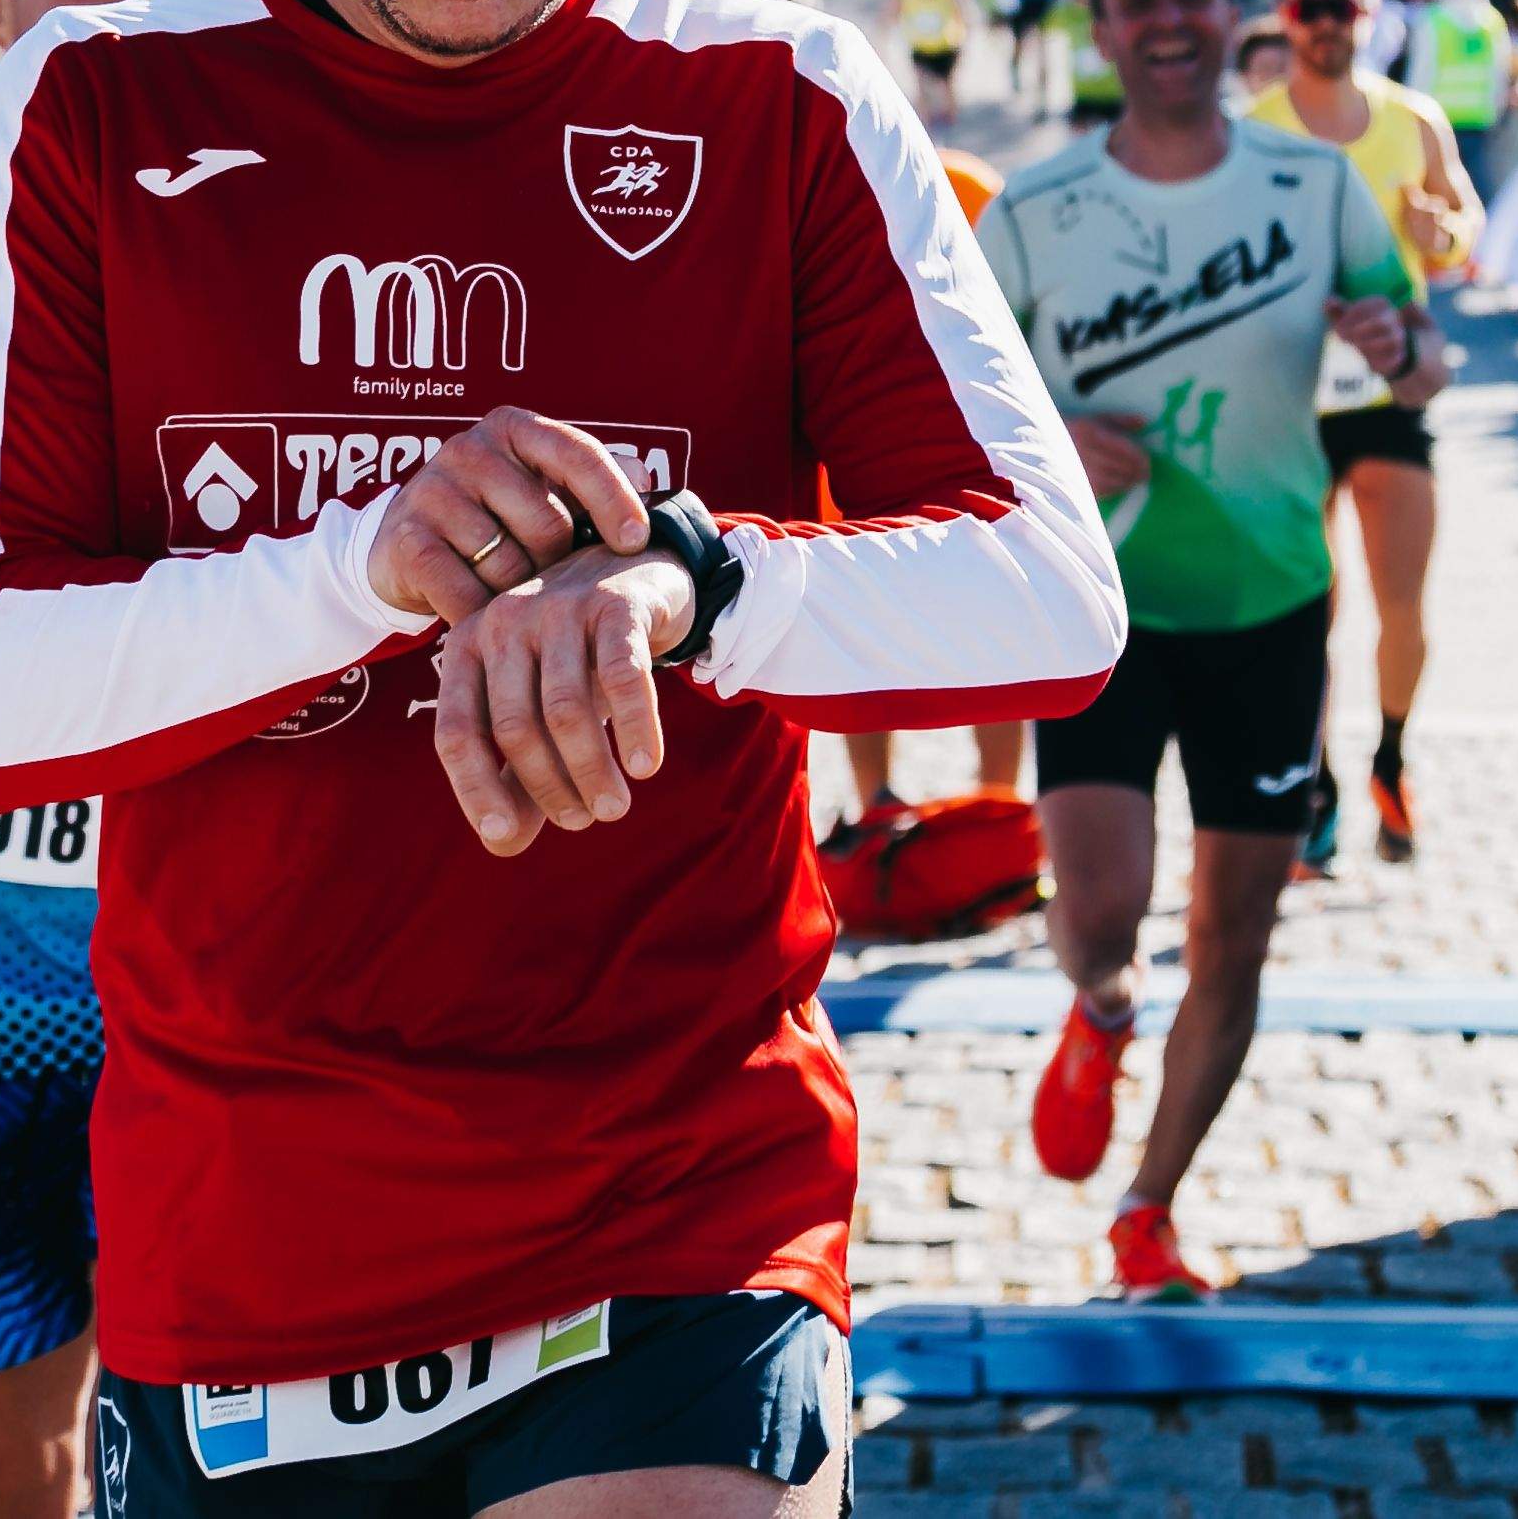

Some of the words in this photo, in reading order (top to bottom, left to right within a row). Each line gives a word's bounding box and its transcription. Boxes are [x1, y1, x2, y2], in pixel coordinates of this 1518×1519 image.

[610, 146, 653, 157] CDA
[590, 203, 673, 218] VALMOJADO
[353, 376, 410, 399] family
[414, 378, 464, 400] place
